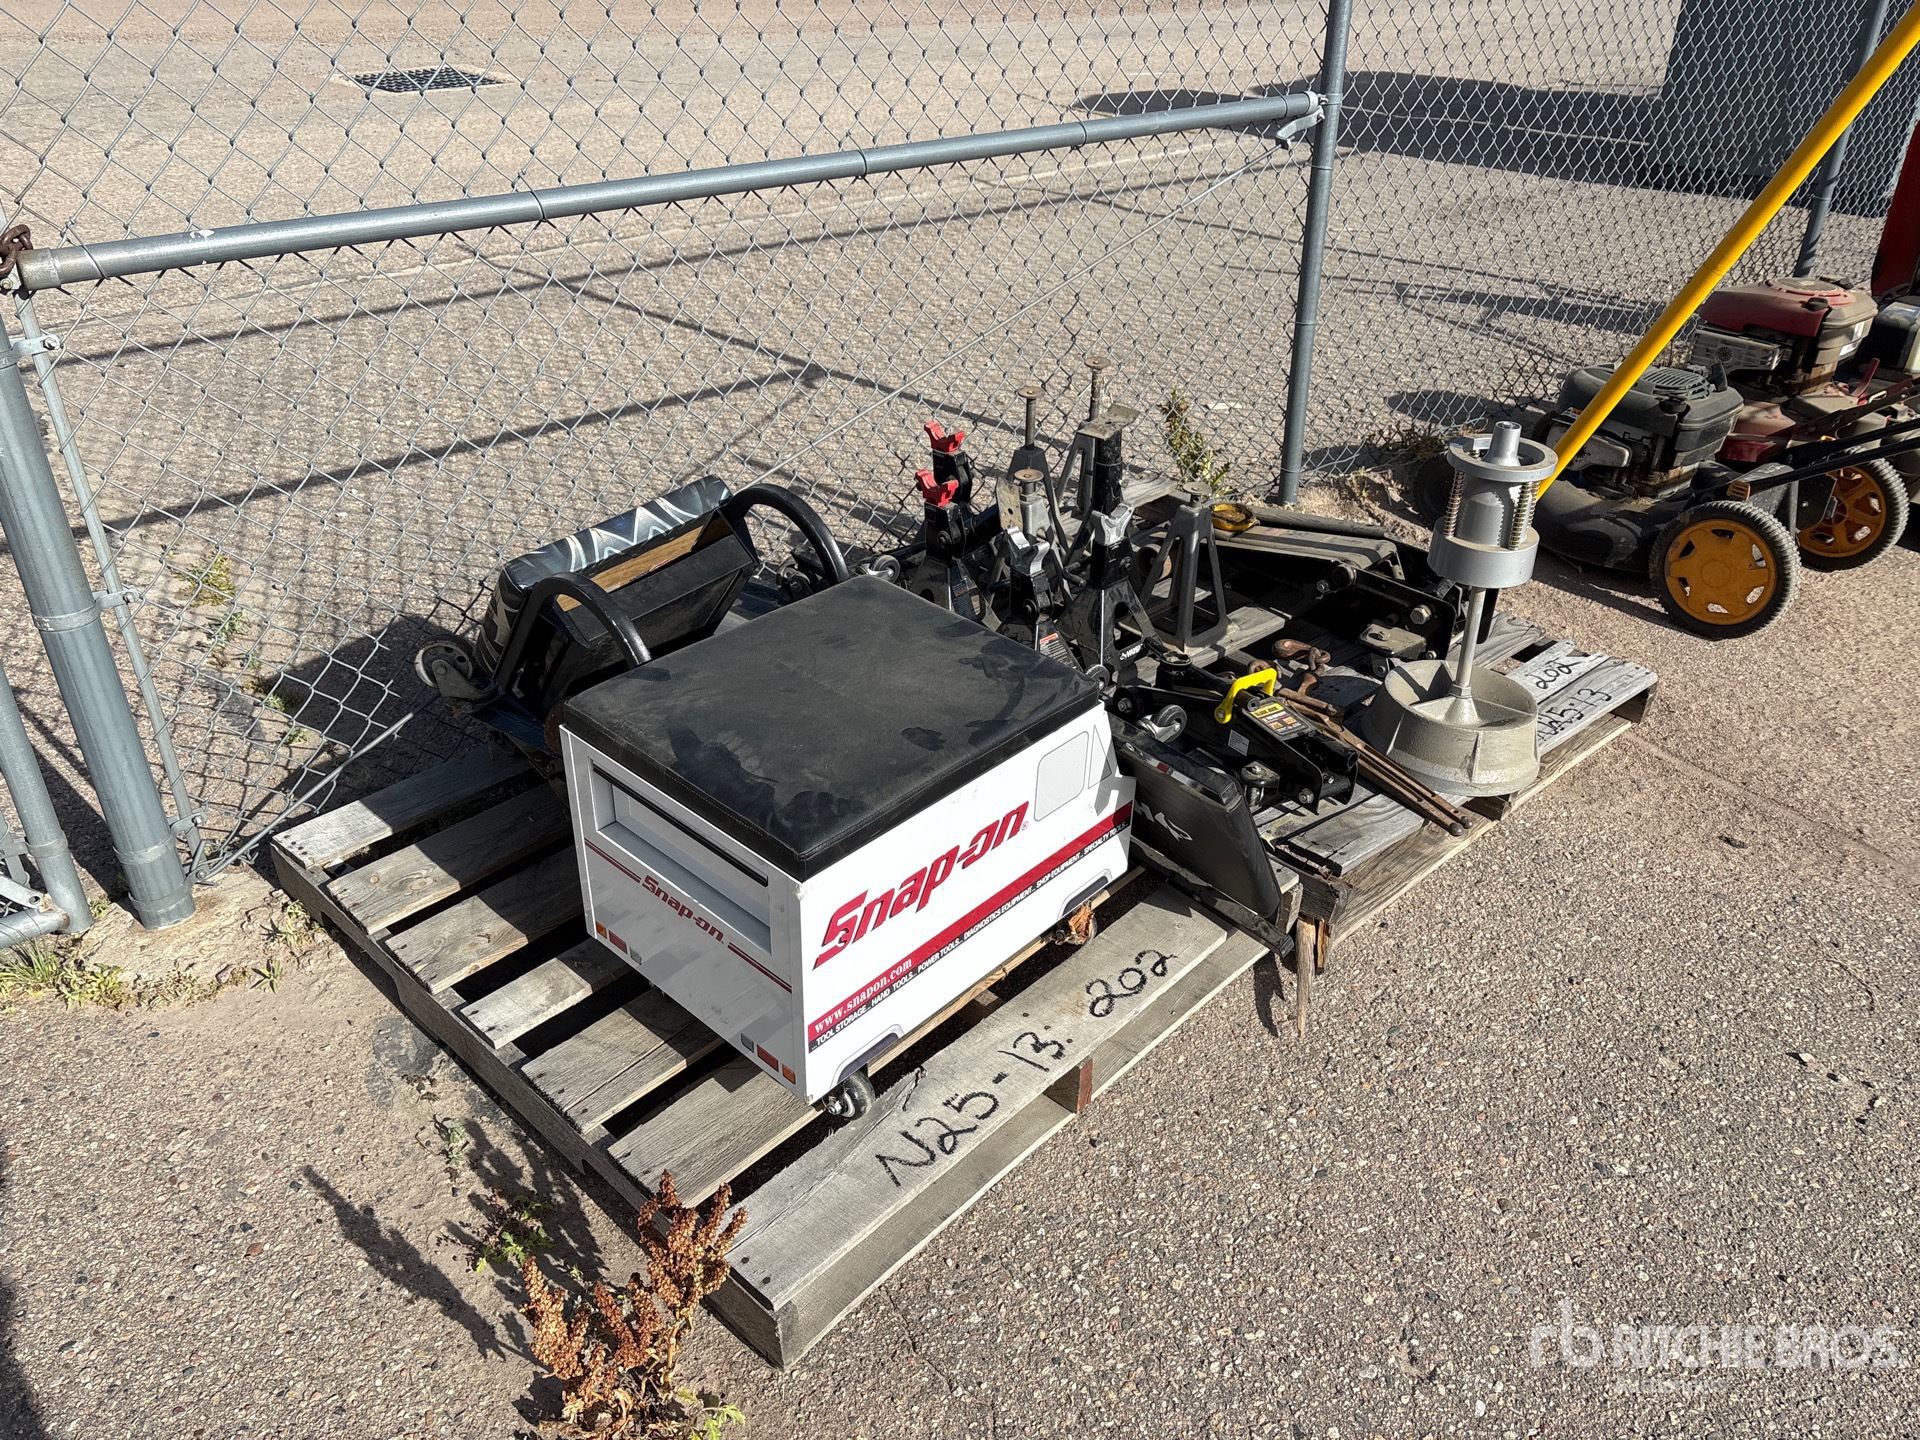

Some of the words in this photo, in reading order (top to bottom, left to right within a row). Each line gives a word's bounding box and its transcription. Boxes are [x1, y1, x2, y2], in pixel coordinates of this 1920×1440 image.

[641, 875, 724, 942] Snap-on
[871, 988, 891, 1006] HAND
[917, 952, 940, 973] POWER
[963, 909, 1001, 941] DIAGNOSTICS
[1036, 874, 1051, 888] SHOP
[814, 958, 913, 1034] www.snapon.com
